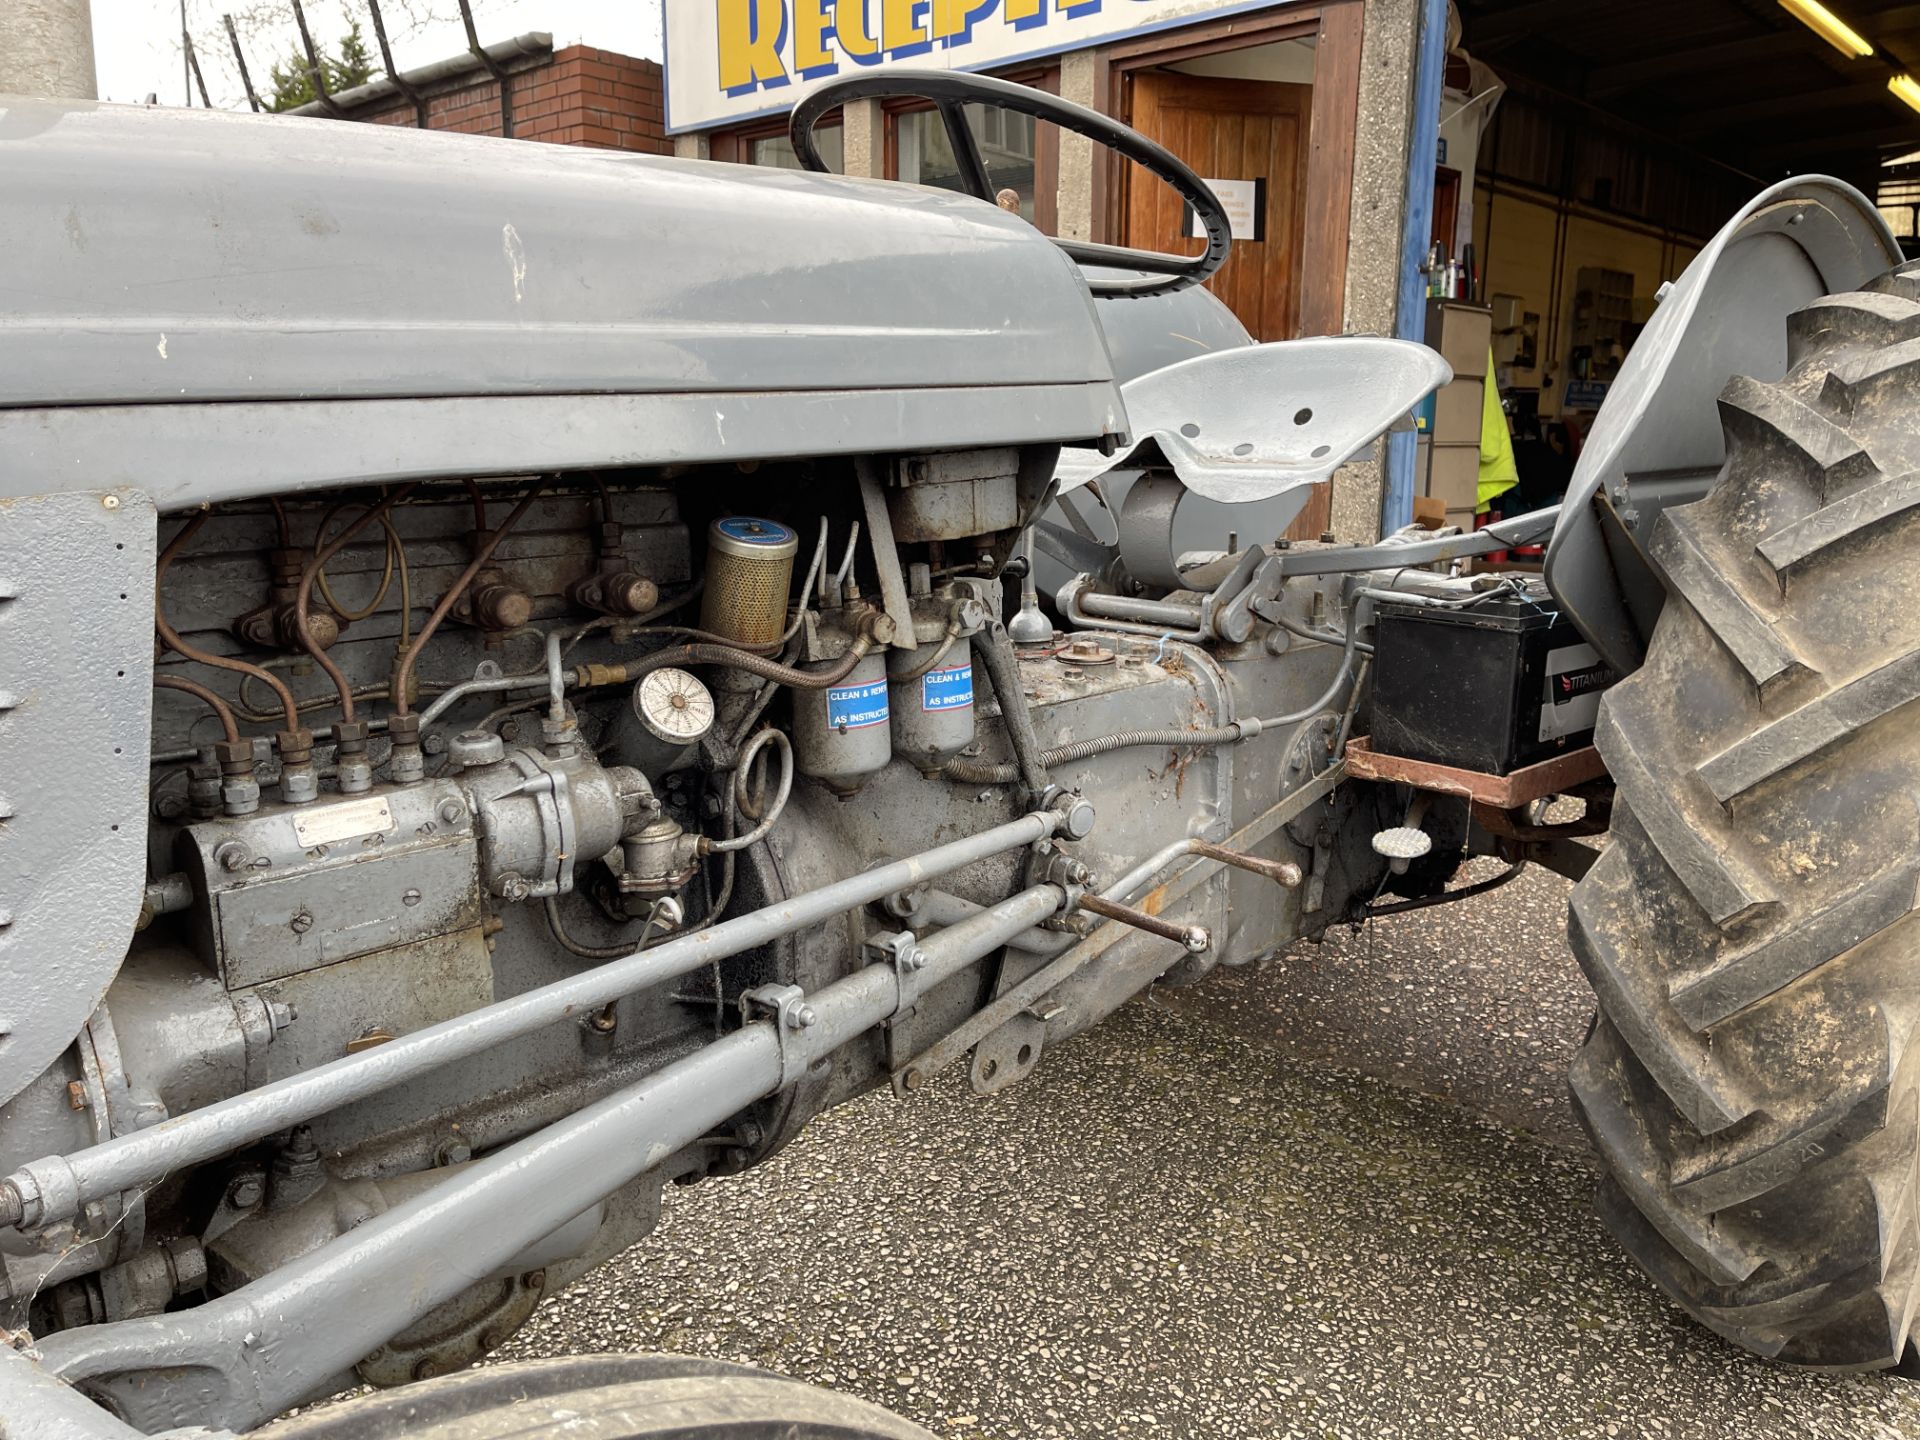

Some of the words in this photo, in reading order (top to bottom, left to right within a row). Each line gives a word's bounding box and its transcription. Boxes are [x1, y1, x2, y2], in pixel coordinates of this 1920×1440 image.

[926, 673, 953, 684] CLEAN
[955, 673, 960, 681] &
[1570, 669, 1615, 690] TITANIUM
[830, 691, 860, 701] CLEAN
[862, 689, 869, 698] &
[929, 697, 941, 705] AS
[834, 715, 847, 724] AS
